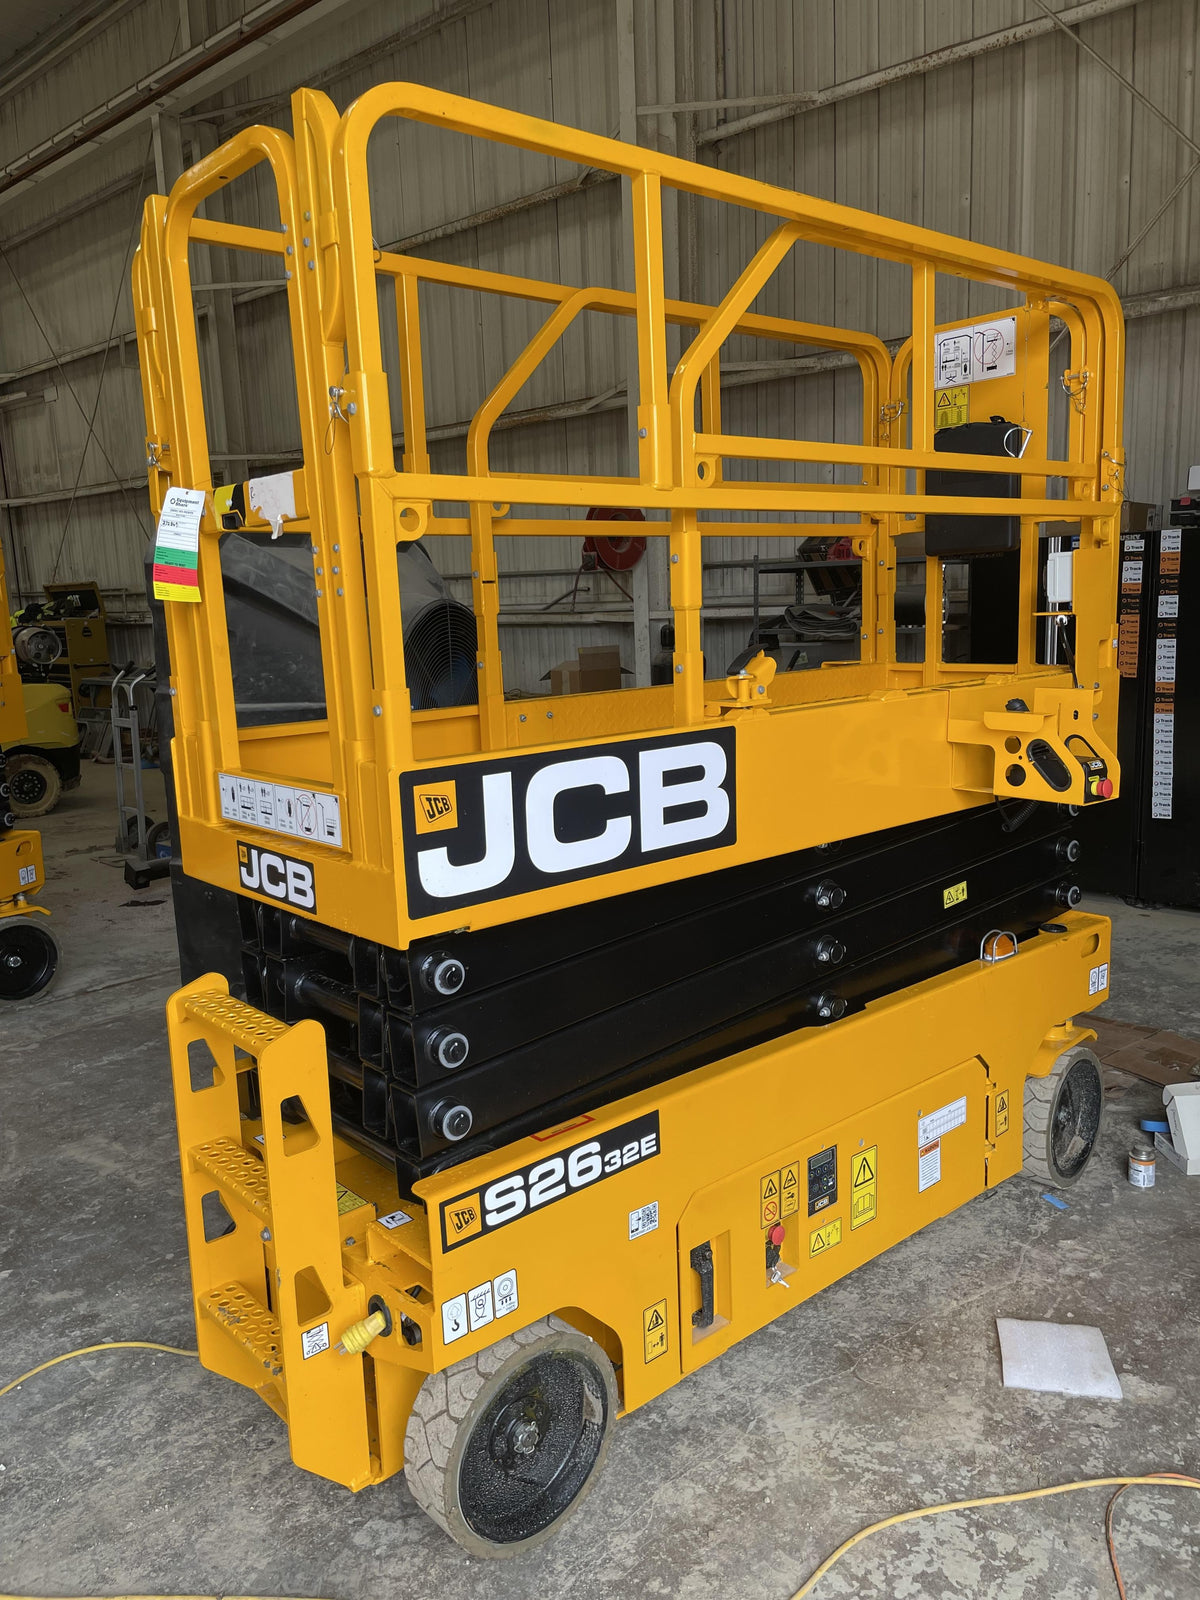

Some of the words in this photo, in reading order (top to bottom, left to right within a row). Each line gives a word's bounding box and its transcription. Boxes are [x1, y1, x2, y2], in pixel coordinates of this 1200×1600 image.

[417, 741, 730, 898] JCB
[425, 796, 451, 819] JCB
[240, 848, 315, 909] JCB
[454, 1208, 476, 1230] JCB
